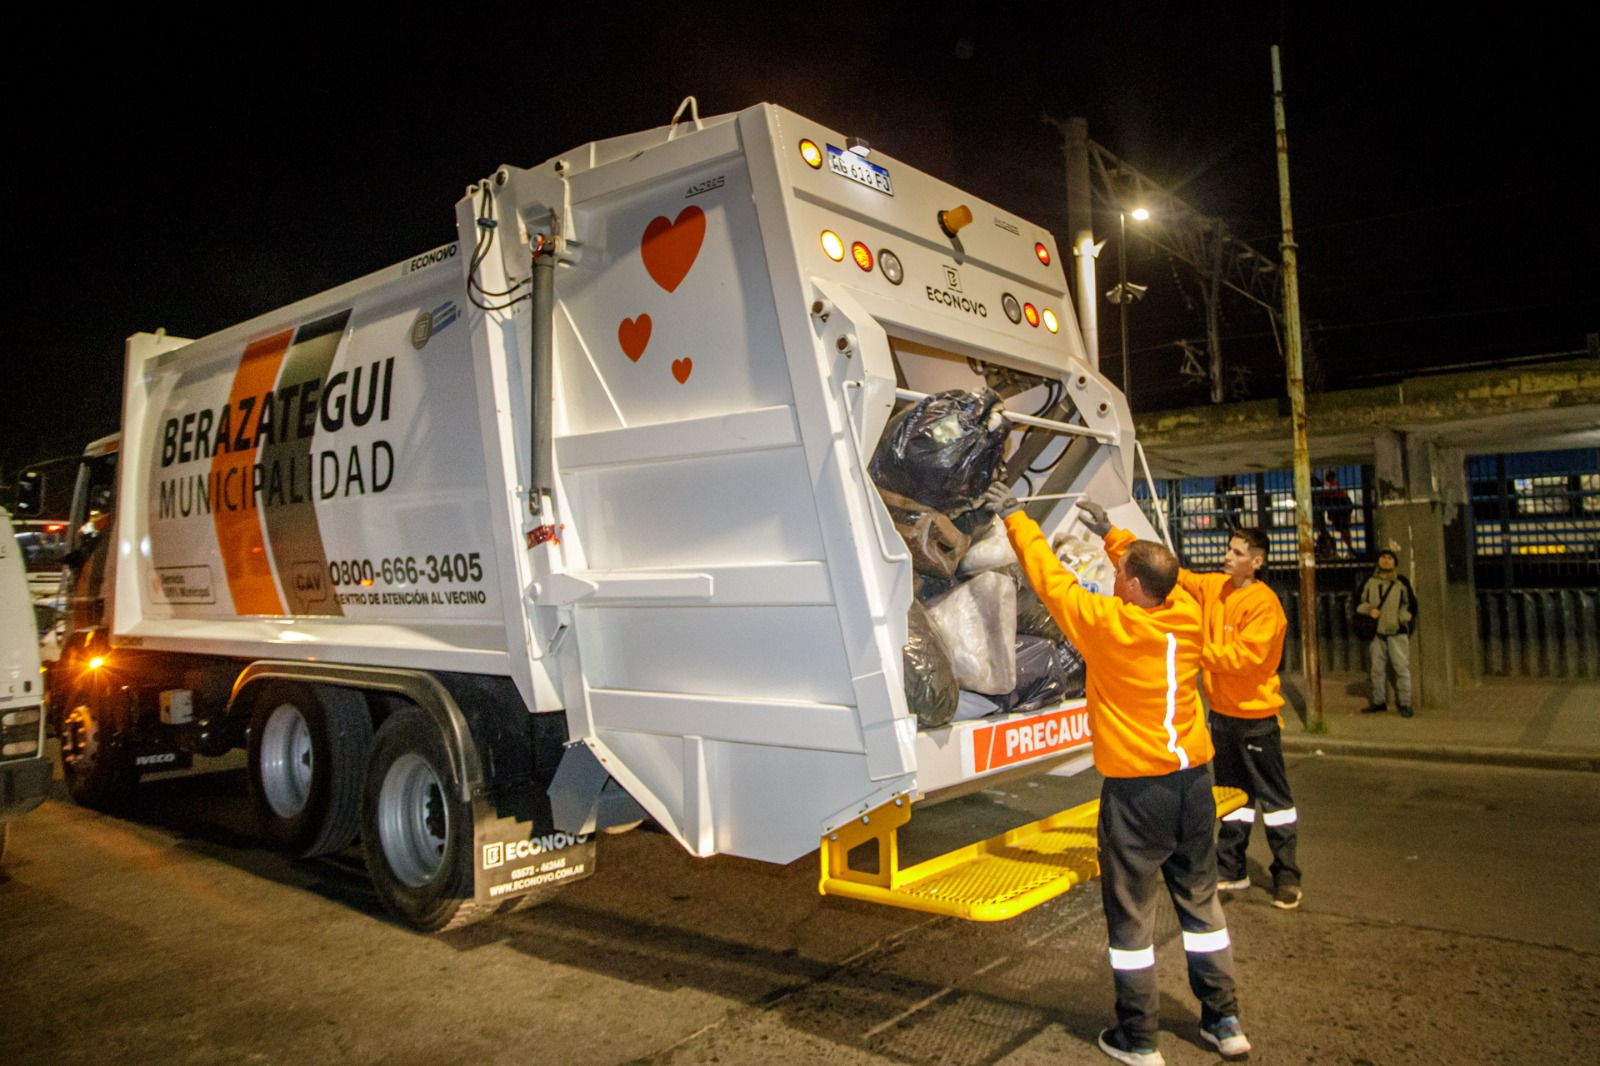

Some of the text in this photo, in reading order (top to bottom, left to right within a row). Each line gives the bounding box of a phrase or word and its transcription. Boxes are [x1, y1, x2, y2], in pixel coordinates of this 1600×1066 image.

[874, 172, 890, 192] FJ
[410, 244, 457, 272] ECONOVO
[926, 285, 988, 318] ECONOVO
[161, 356, 396, 468] BERAZATEGUI
[158, 440, 395, 520] MUNICIPALIDAD
[329, 552, 483, 587] 0800-666-3405
[333, 588, 486, 606] CENTRO DE ATENCIÓN AL VECINO
[506, 832, 588, 861] ECONOVO
[489, 863, 585, 897] WWW.ECONOVO.COM.AR
